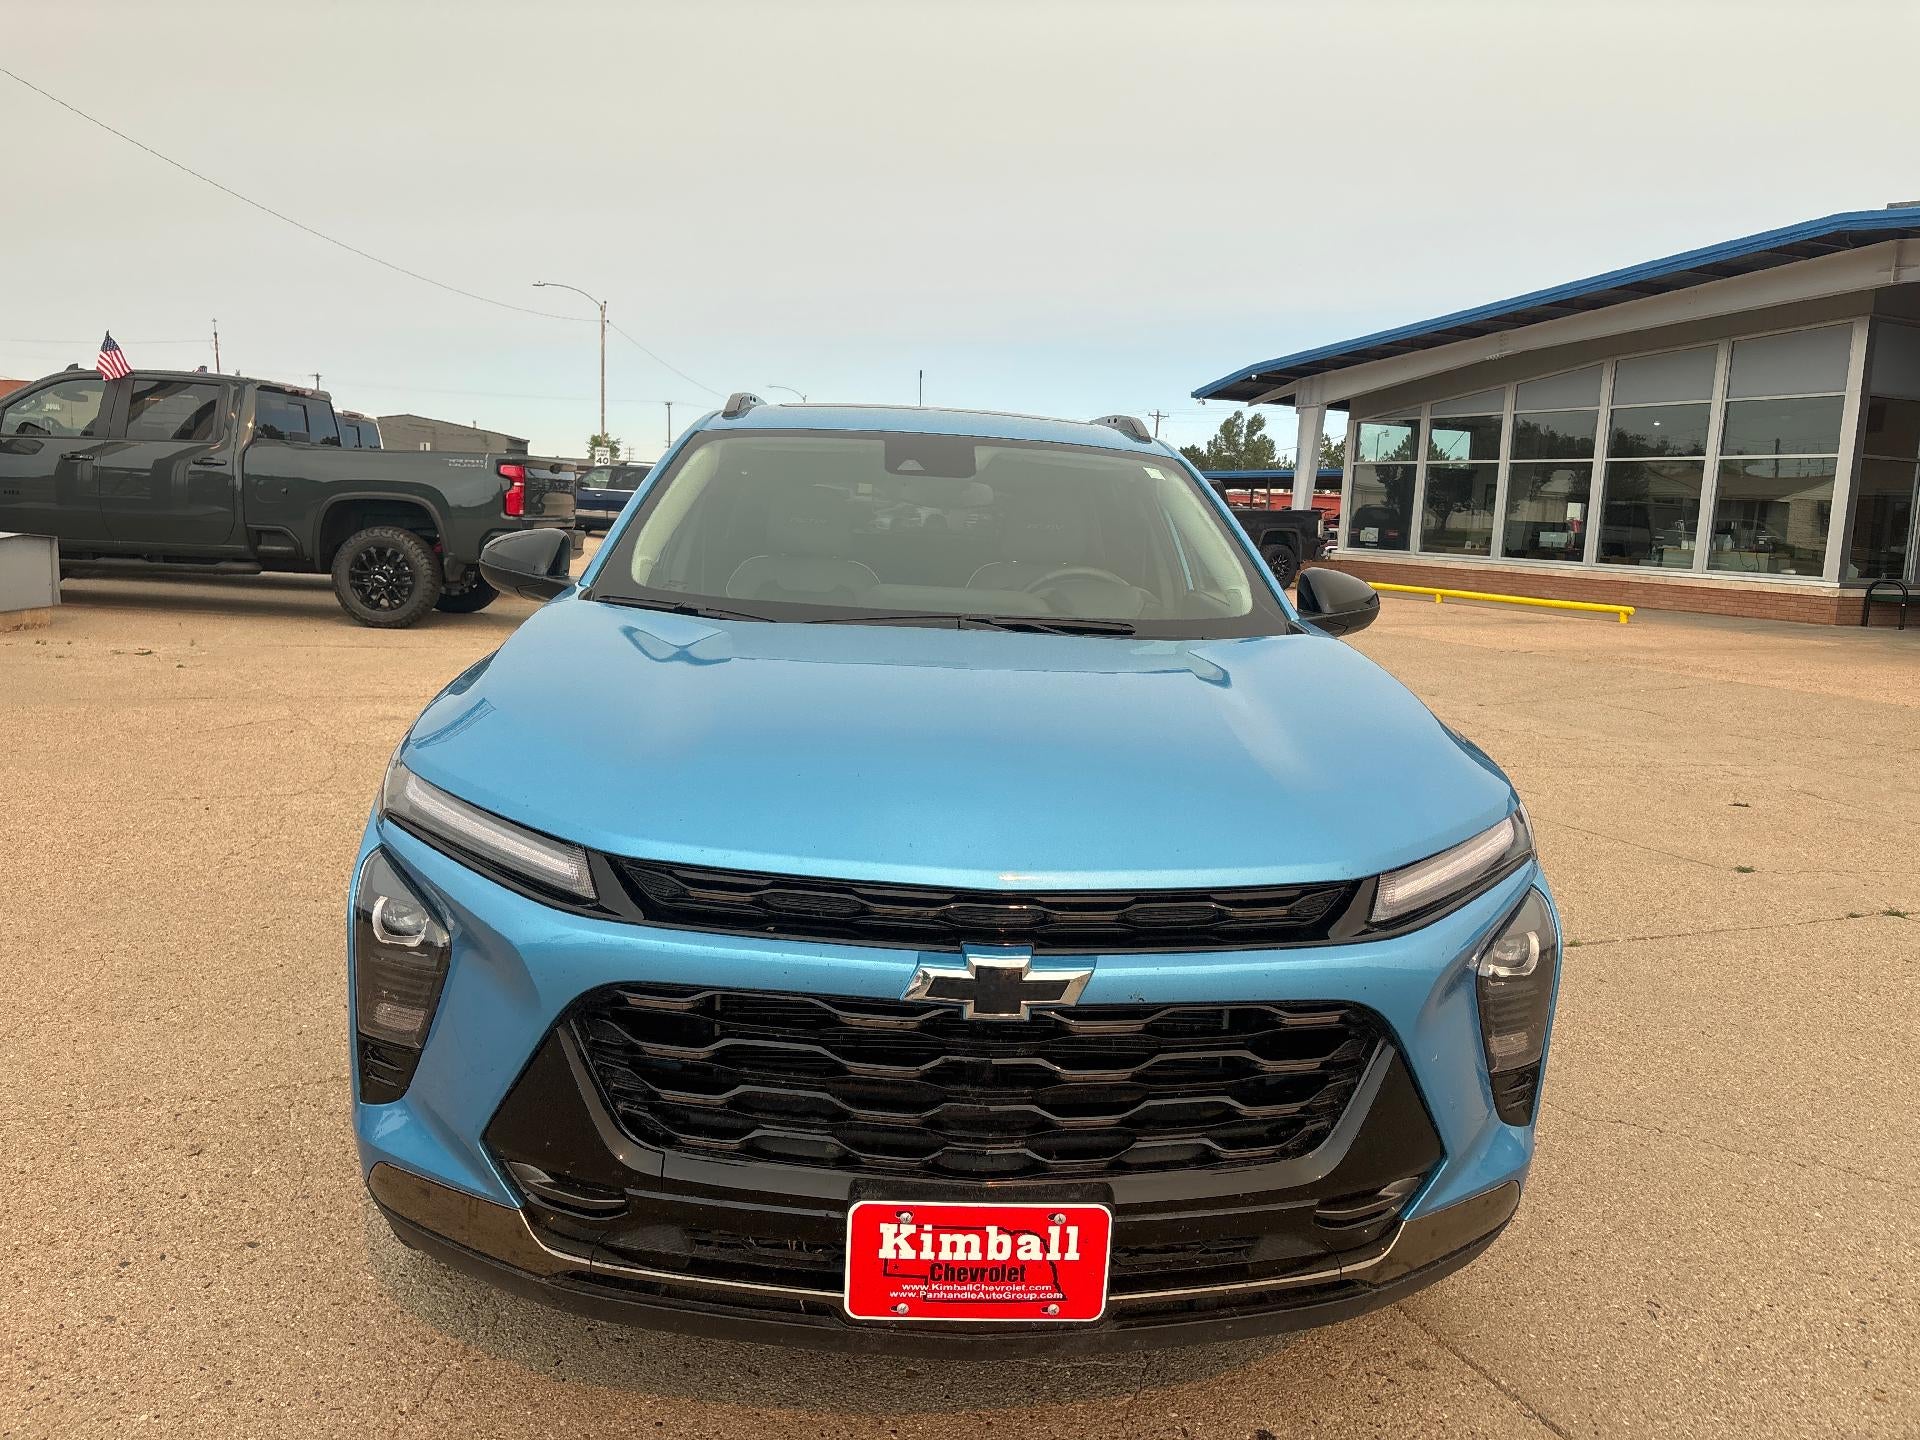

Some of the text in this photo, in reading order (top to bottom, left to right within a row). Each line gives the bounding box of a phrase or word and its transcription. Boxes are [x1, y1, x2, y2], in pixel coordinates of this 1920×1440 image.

[878, 1222, 1080, 1261] Kimball
[929, 1263, 1026, 1283] Chevrolet
[901, 1283, 1052, 1292] www.KimballChevrolet.com
[889, 1290, 1064, 1301] www.PanhandleAutoGroup.com
